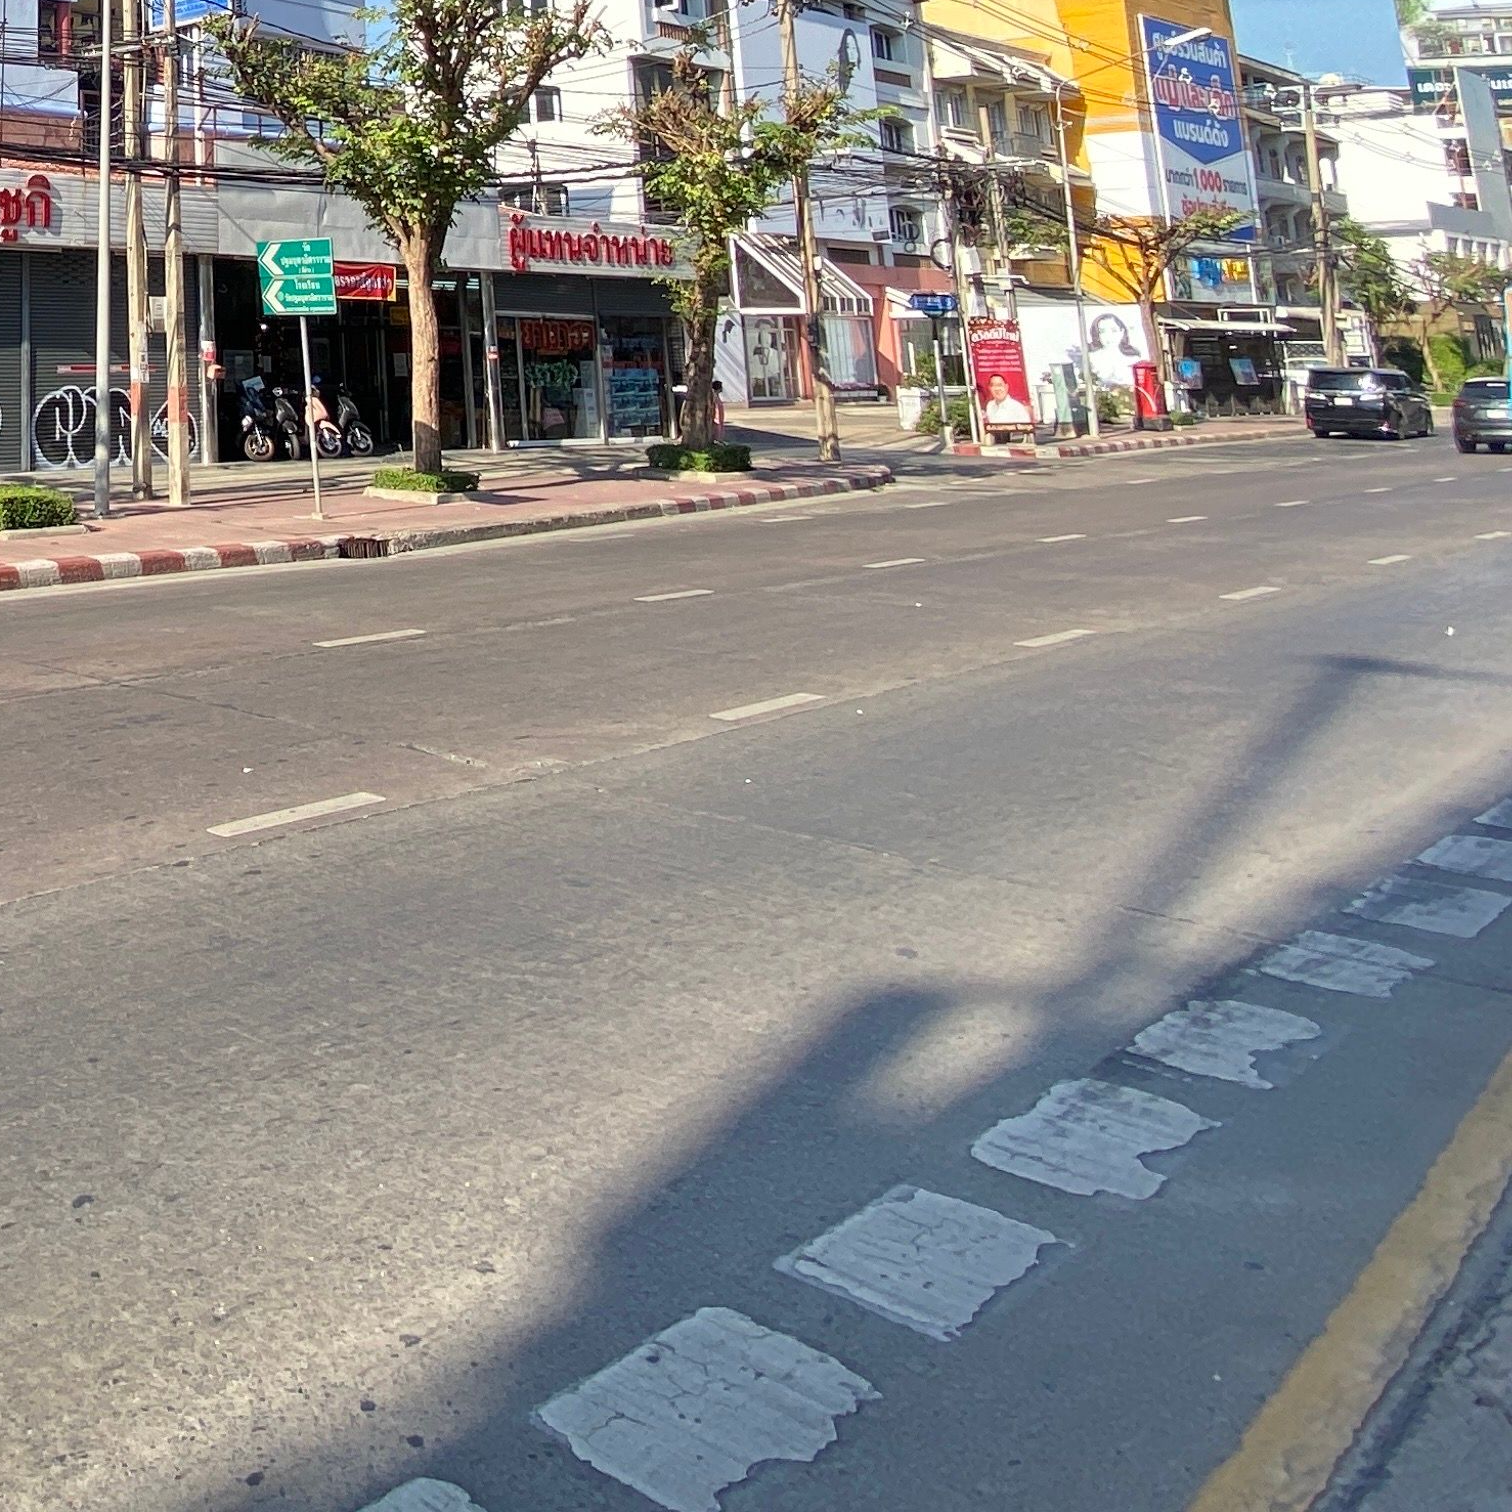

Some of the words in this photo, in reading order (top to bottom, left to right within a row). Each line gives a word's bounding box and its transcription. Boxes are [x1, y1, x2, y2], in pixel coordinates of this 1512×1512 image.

[1152, 30, 1227, 68] ศู์รวมสินค้า
